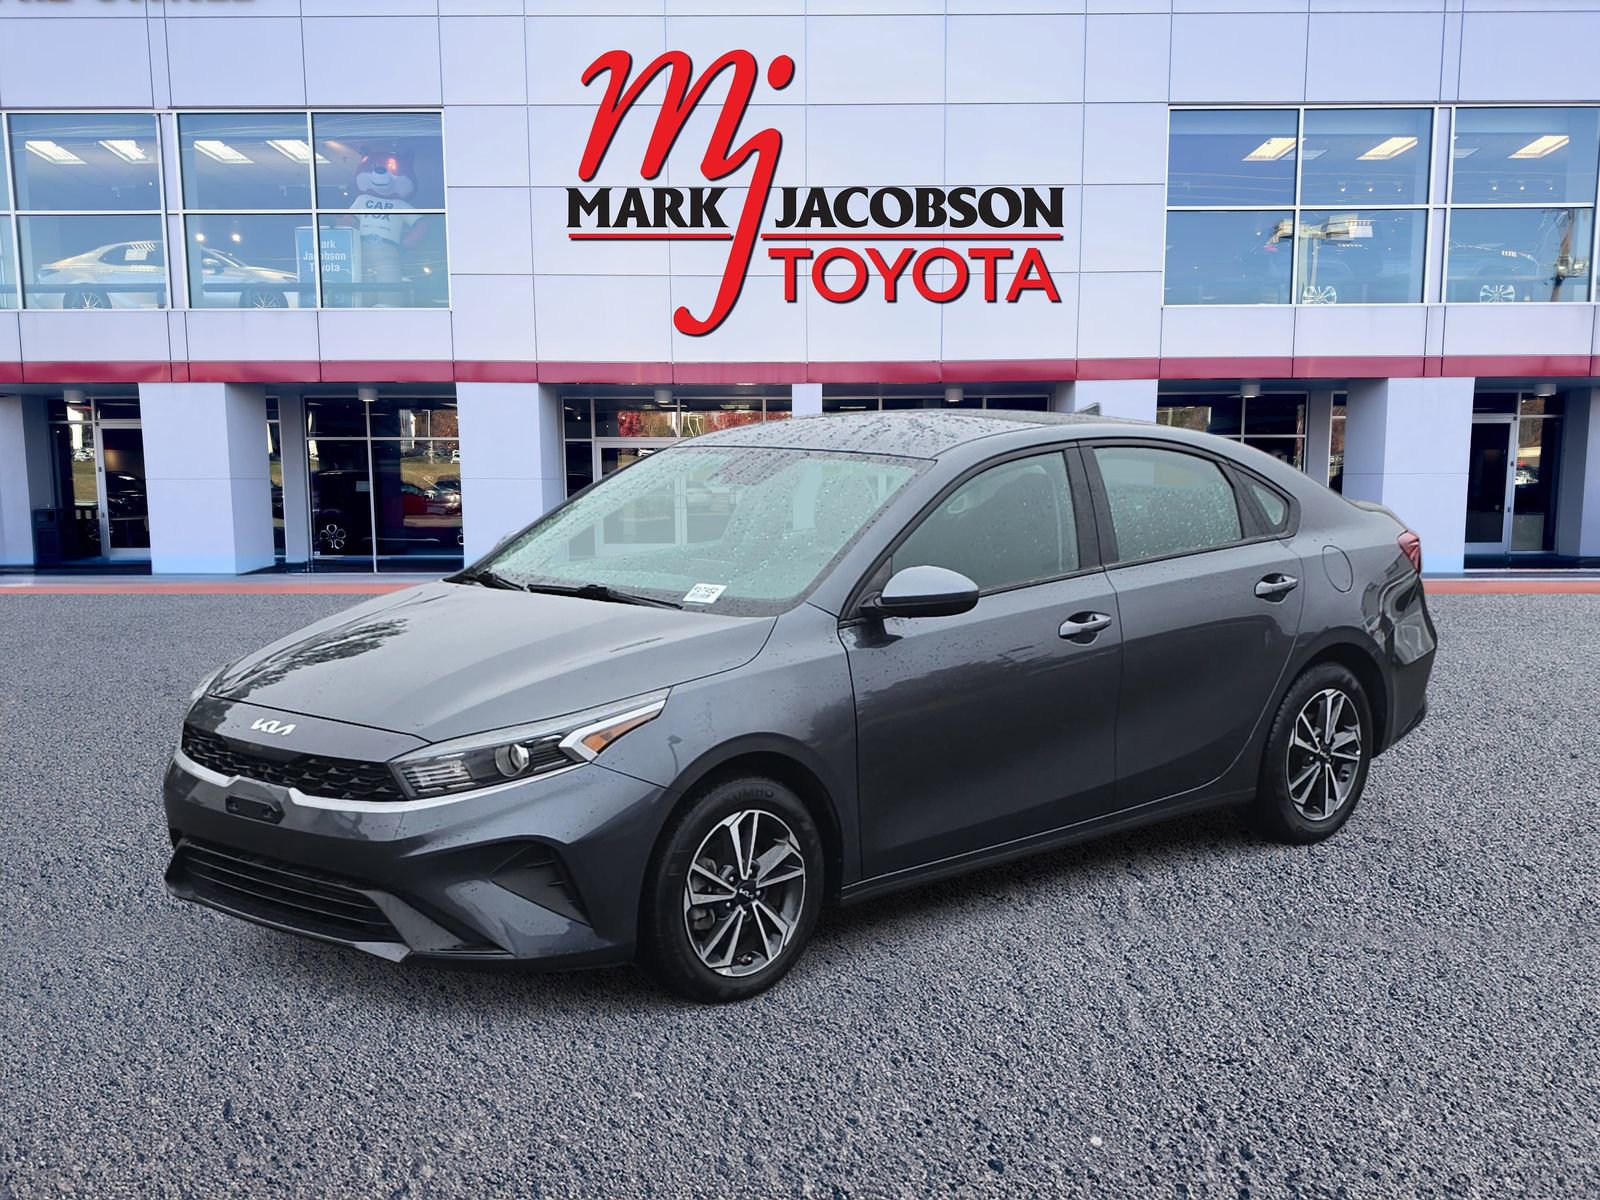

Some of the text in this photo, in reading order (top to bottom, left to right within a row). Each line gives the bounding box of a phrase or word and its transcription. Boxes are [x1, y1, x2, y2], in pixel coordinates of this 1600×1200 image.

[565, 186, 1065, 229] MARK JACOBSON
[767, 246, 1063, 304] TOYOTA
